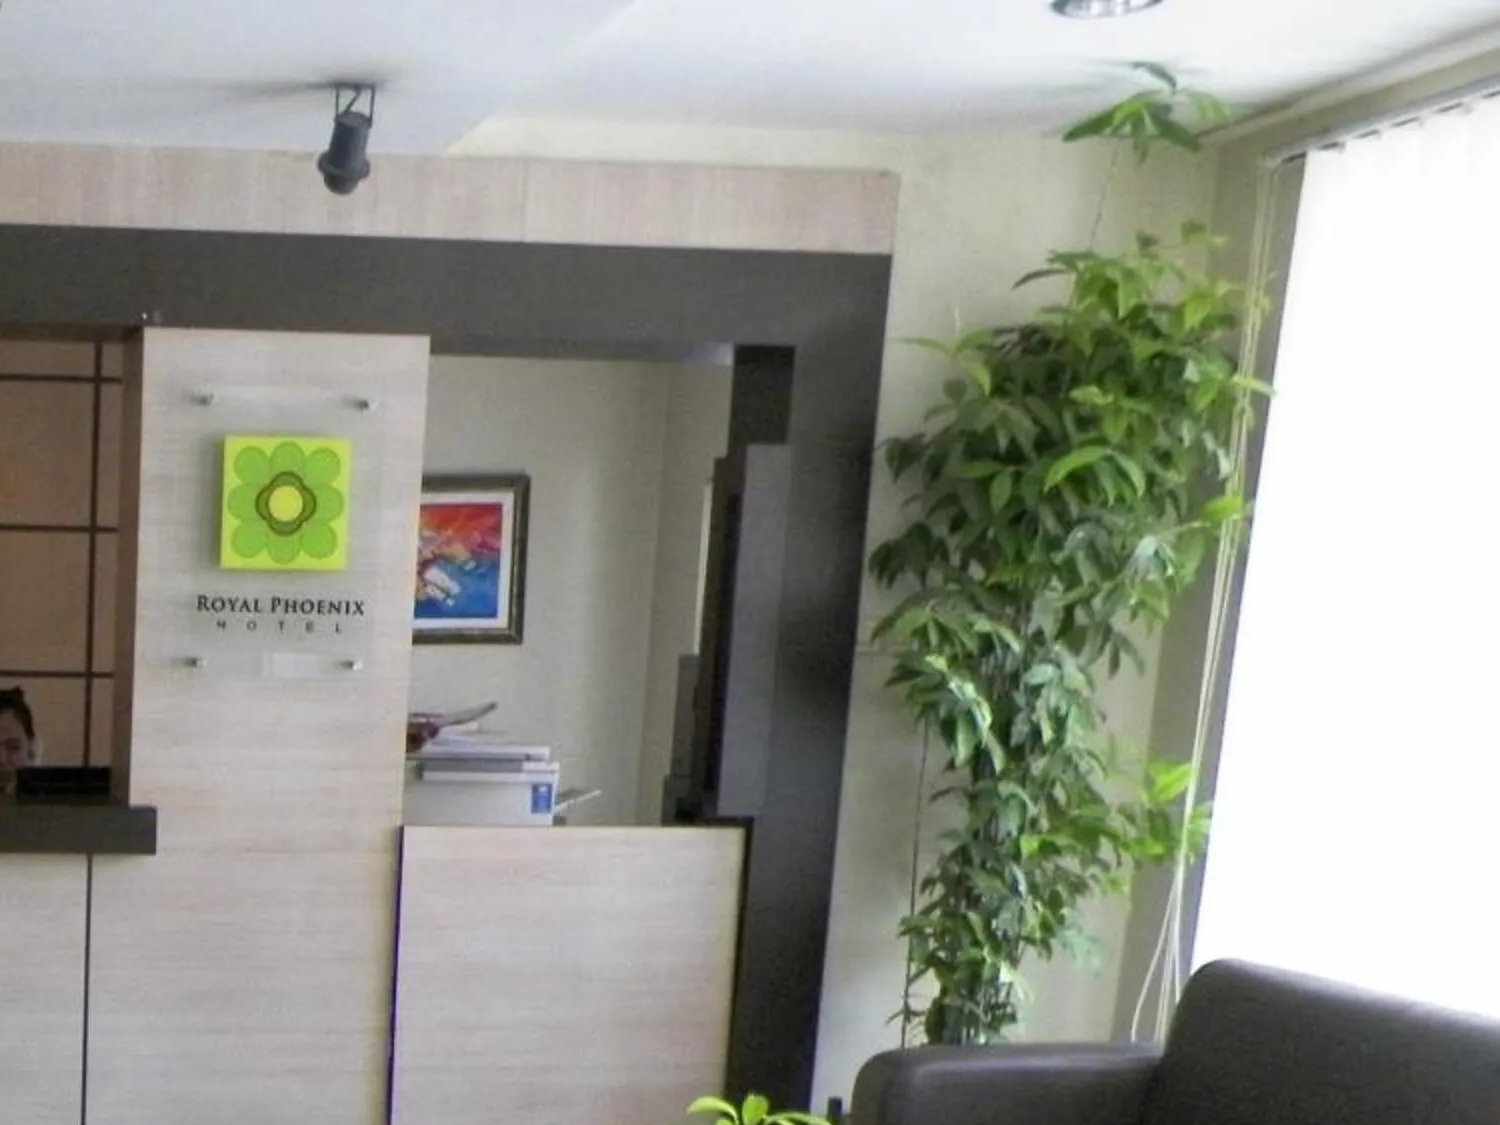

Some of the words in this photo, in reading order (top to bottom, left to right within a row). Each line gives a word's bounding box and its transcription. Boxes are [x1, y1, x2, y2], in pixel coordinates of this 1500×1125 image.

[197, 595, 262, 613] ROYAL
[271, 595, 365, 616] PHOENIX
[216, 619, 341, 634] HOTEL
